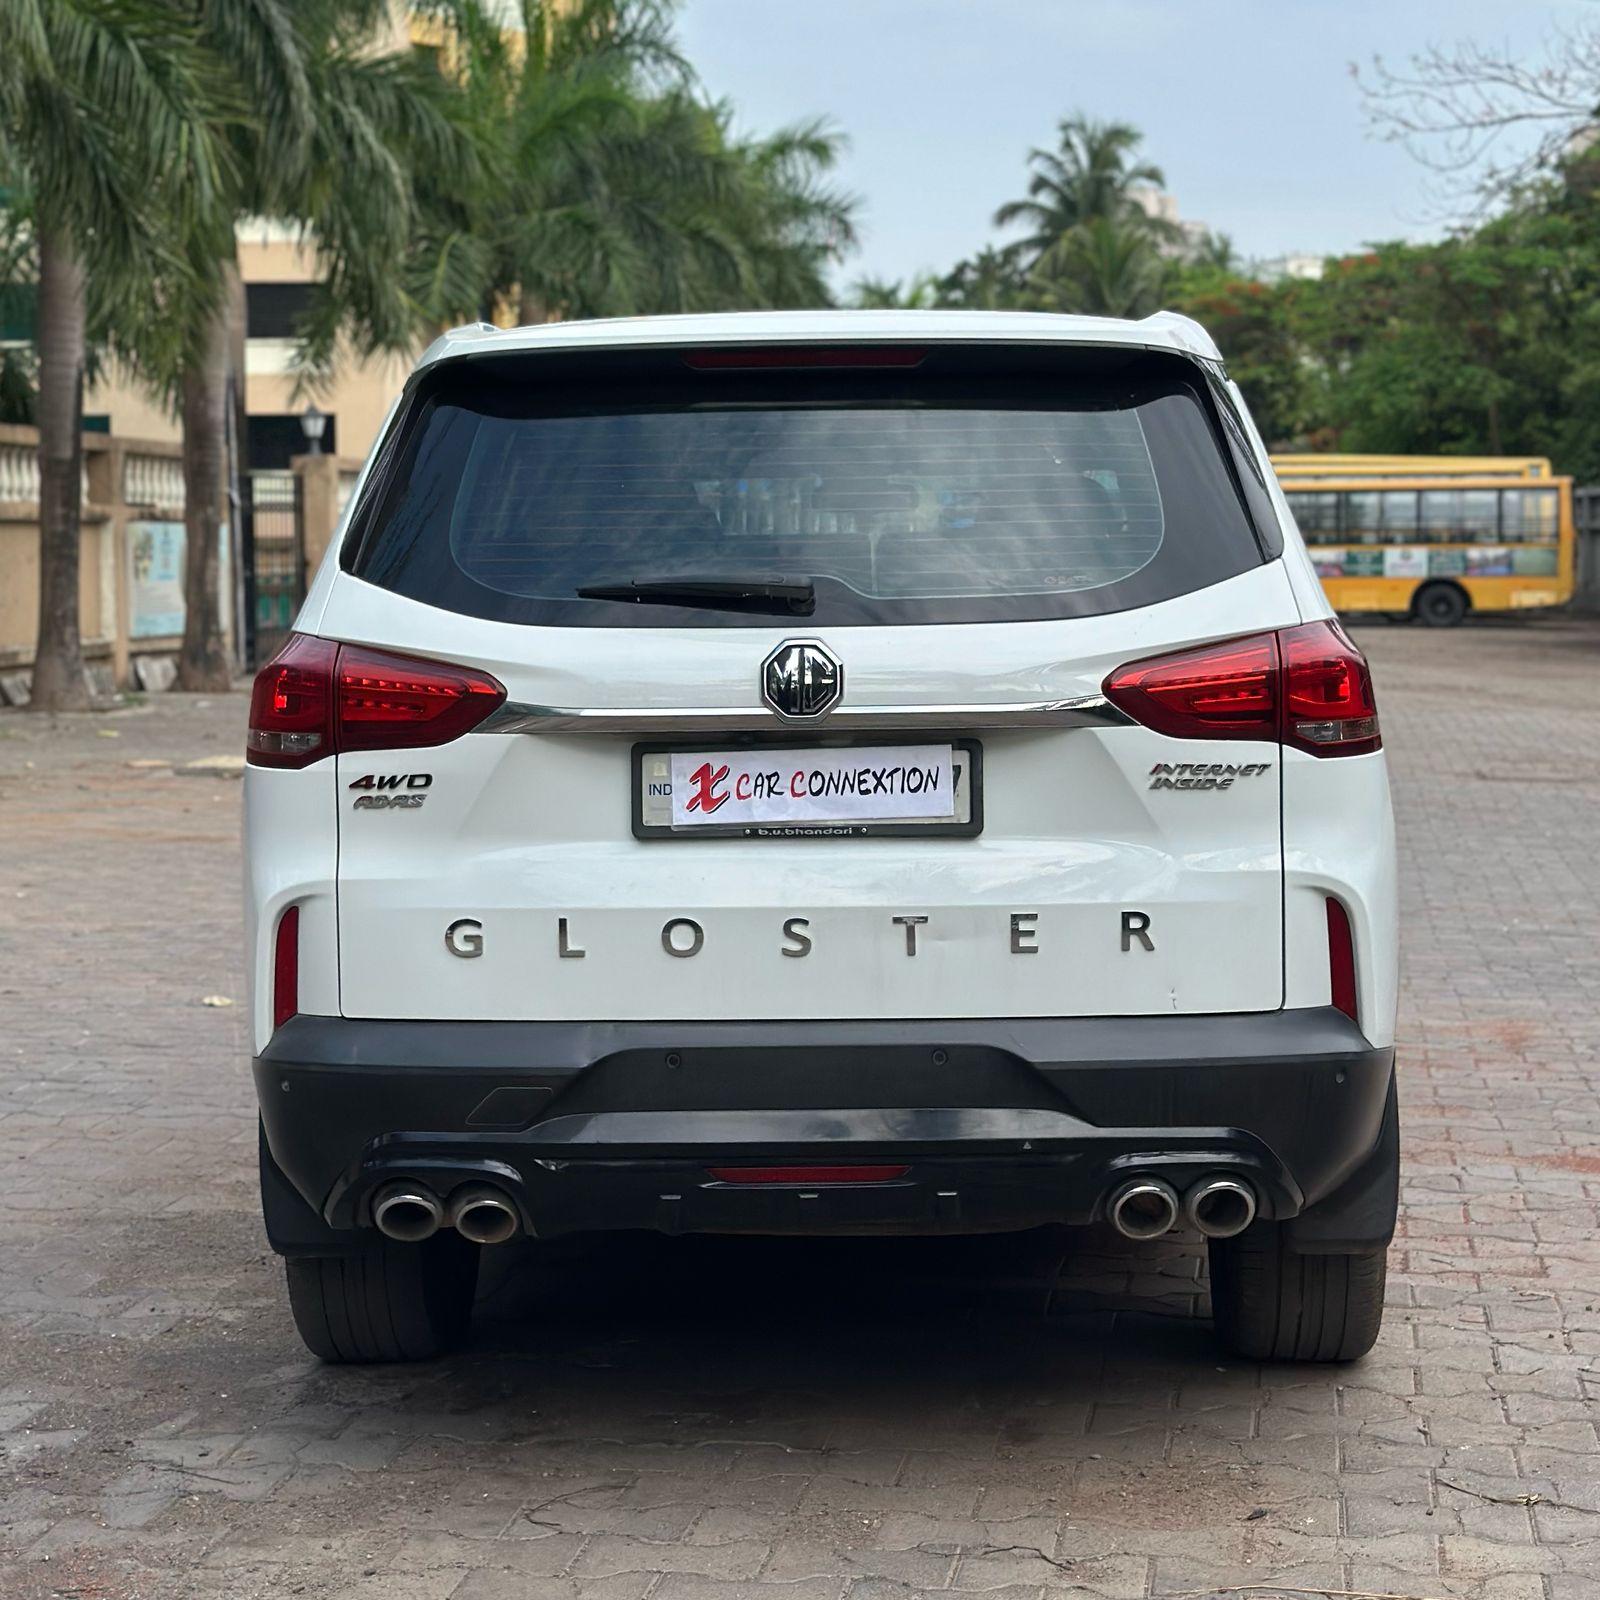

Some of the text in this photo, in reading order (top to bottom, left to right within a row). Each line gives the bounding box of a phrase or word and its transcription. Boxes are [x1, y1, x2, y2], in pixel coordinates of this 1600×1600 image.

[1149, 763, 1272, 776] INTERNET
[348, 773, 433, 790] 4WD
[735, 771, 785, 801] CAR
[790, 766, 939, 799] CONNEXTION
[1149, 777, 1235, 790] INSIDE
[648, 783, 672, 796] IND
[444, 910, 1155, 958] GLOSTER
